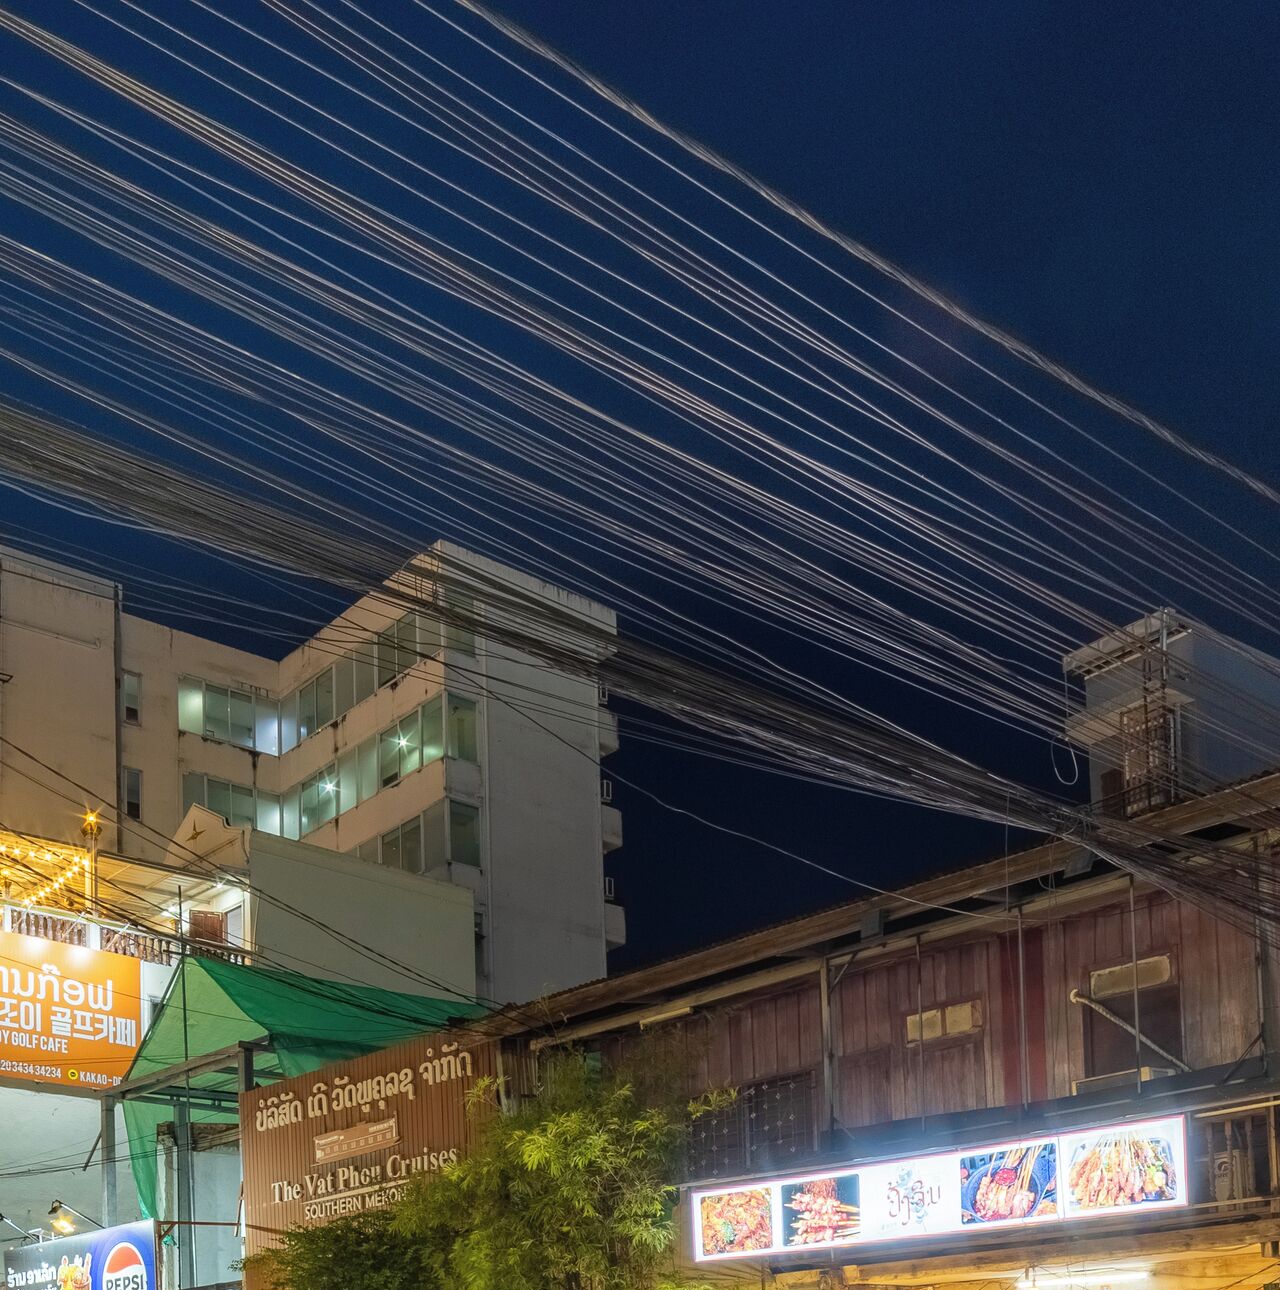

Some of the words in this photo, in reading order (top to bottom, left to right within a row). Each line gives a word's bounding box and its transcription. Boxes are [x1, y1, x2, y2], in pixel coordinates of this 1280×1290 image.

[11, 1031, 39, 1048] GOLF
[40, 1036, 69, 1054] CAFE
[50, 1005, 137, 1048] 골프카페
[271, 1181, 301, 1204] The
[304, 1171, 335, 1197] Vat
[386, 1147, 458, 1178] Cruises
[305, 1196, 363, 1220] SOUTHERN
